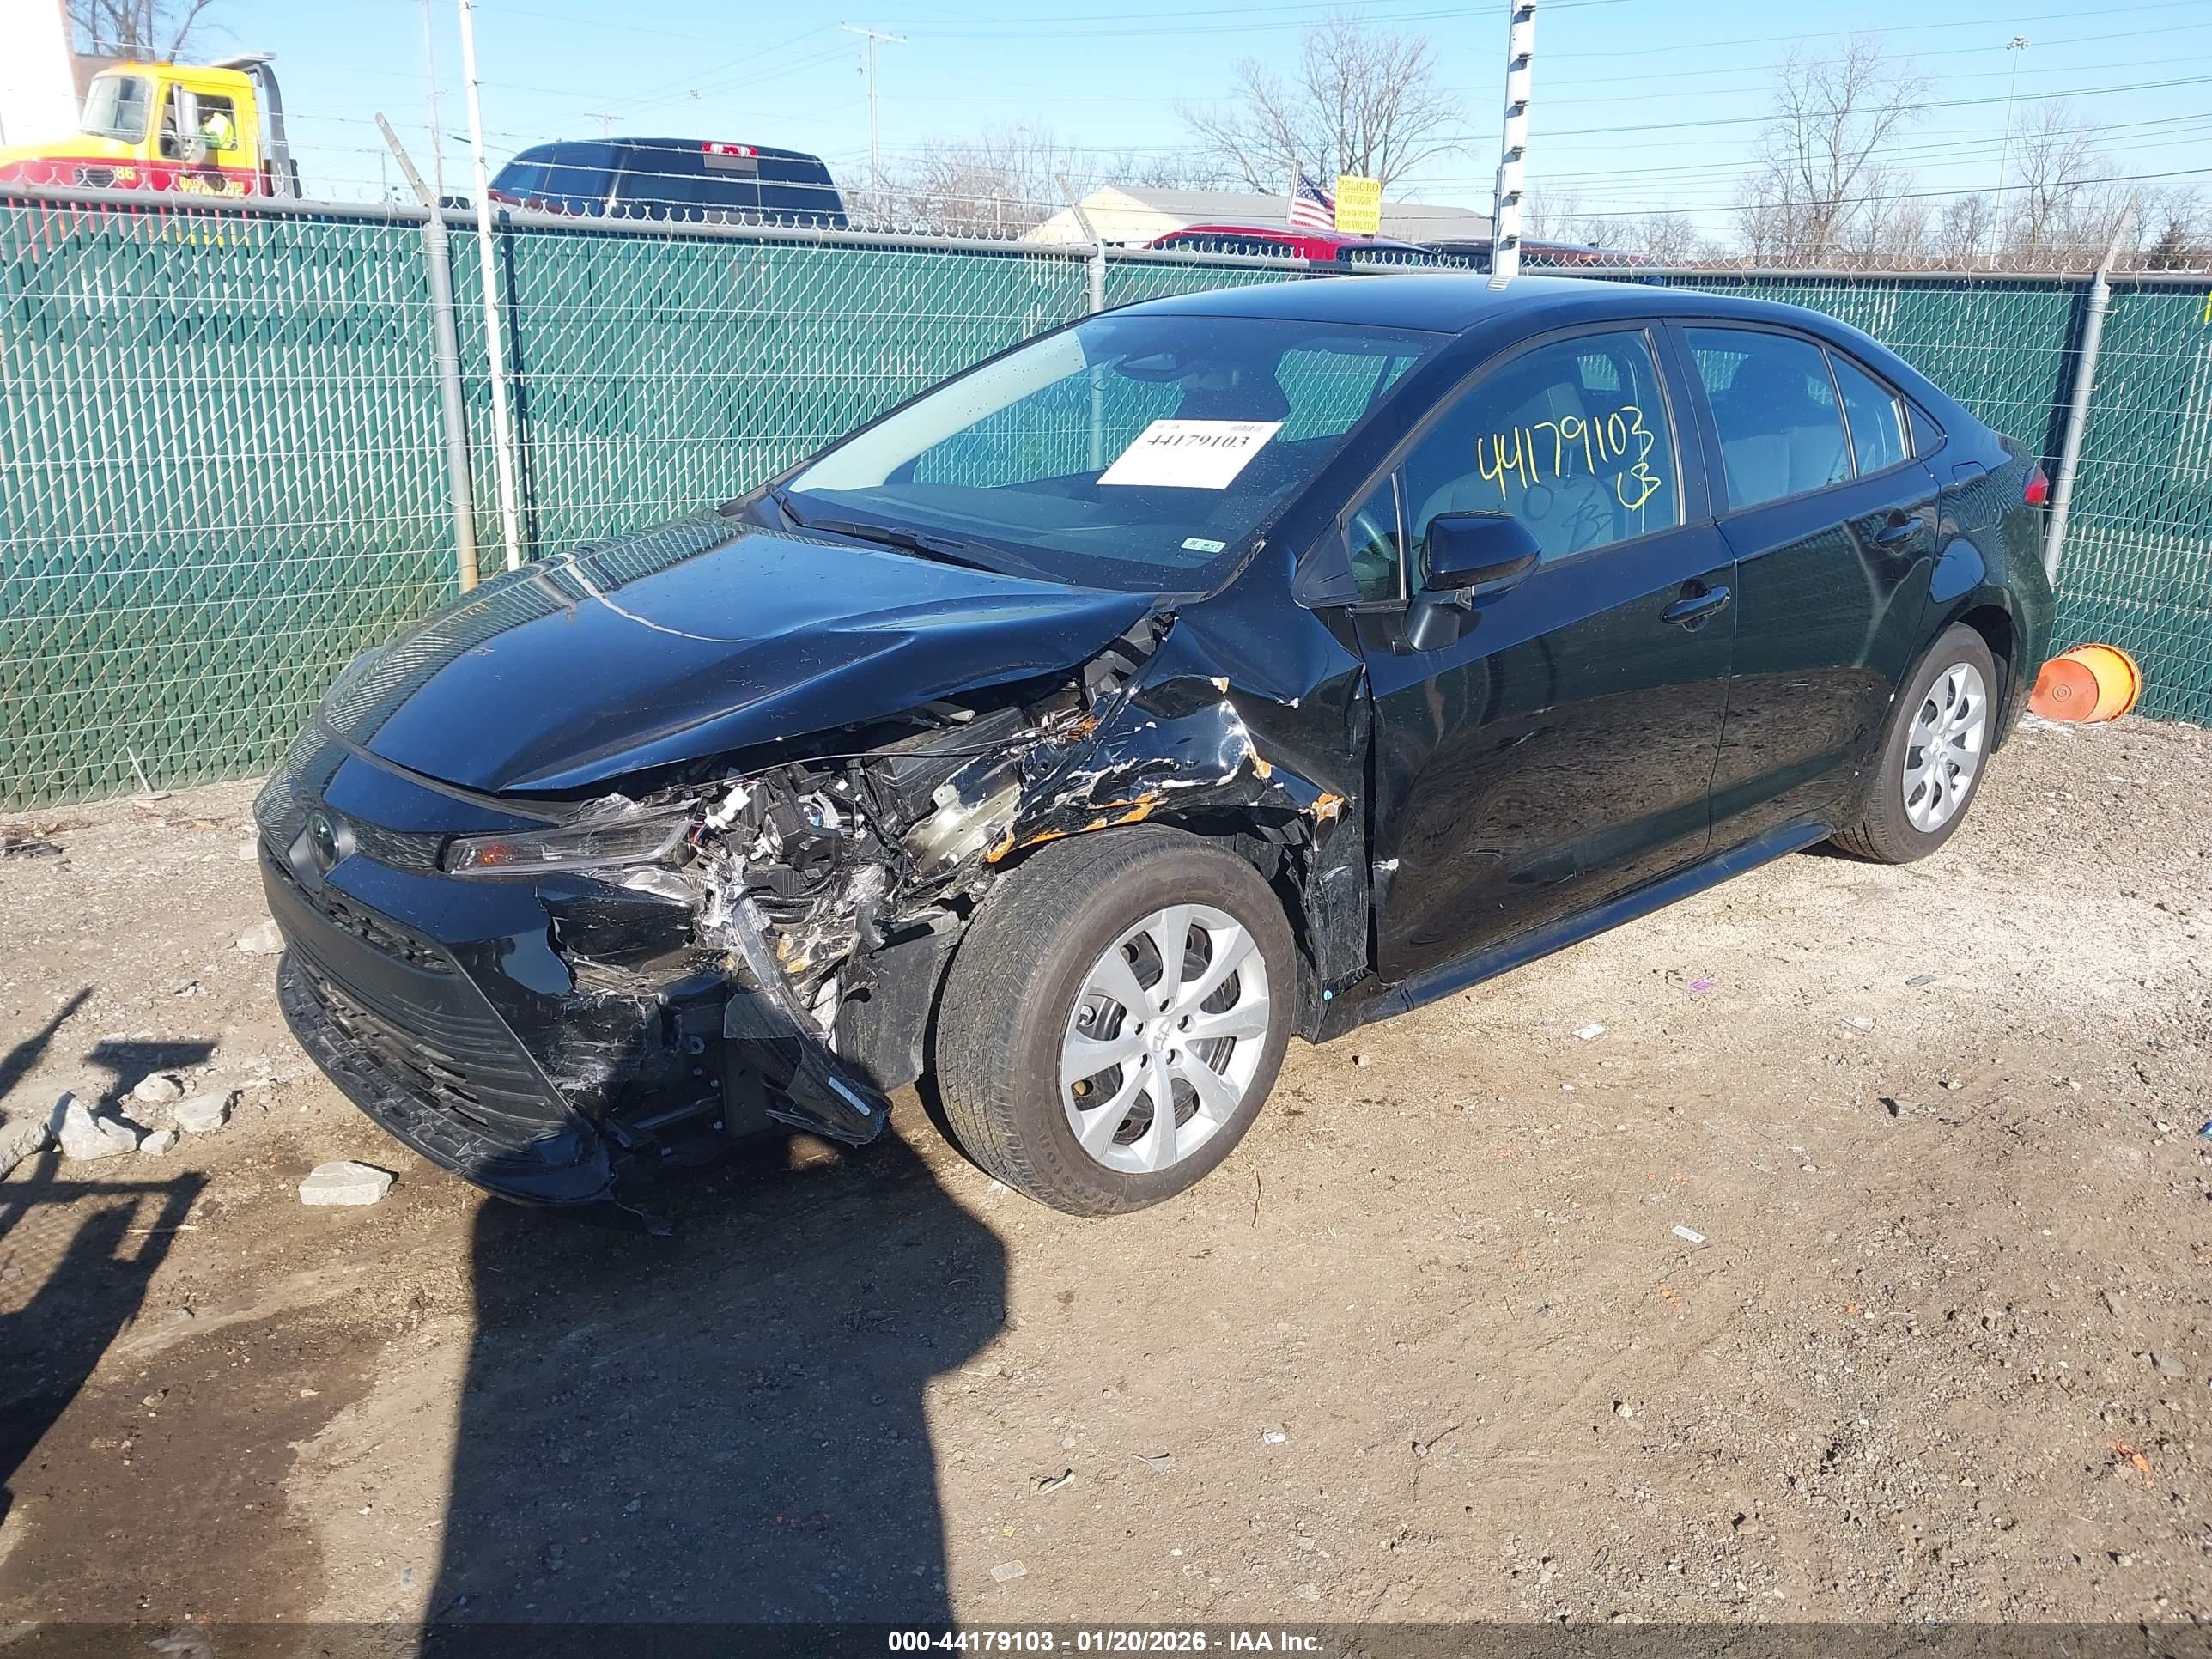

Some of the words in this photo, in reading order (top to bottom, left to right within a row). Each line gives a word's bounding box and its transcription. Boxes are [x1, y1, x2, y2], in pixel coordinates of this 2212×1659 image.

[116, 167, 136, 180] 86
[1339, 180, 1378, 192] PELIGRO
[1344, 195, 1352, 204] NO
[1353, 195, 1372, 206] TOQUE
[1352, 220, 1377, 231] VOLTIOS
[1147, 434, 1250, 448] 44179103
[1476, 405, 1655, 501] 44179103
